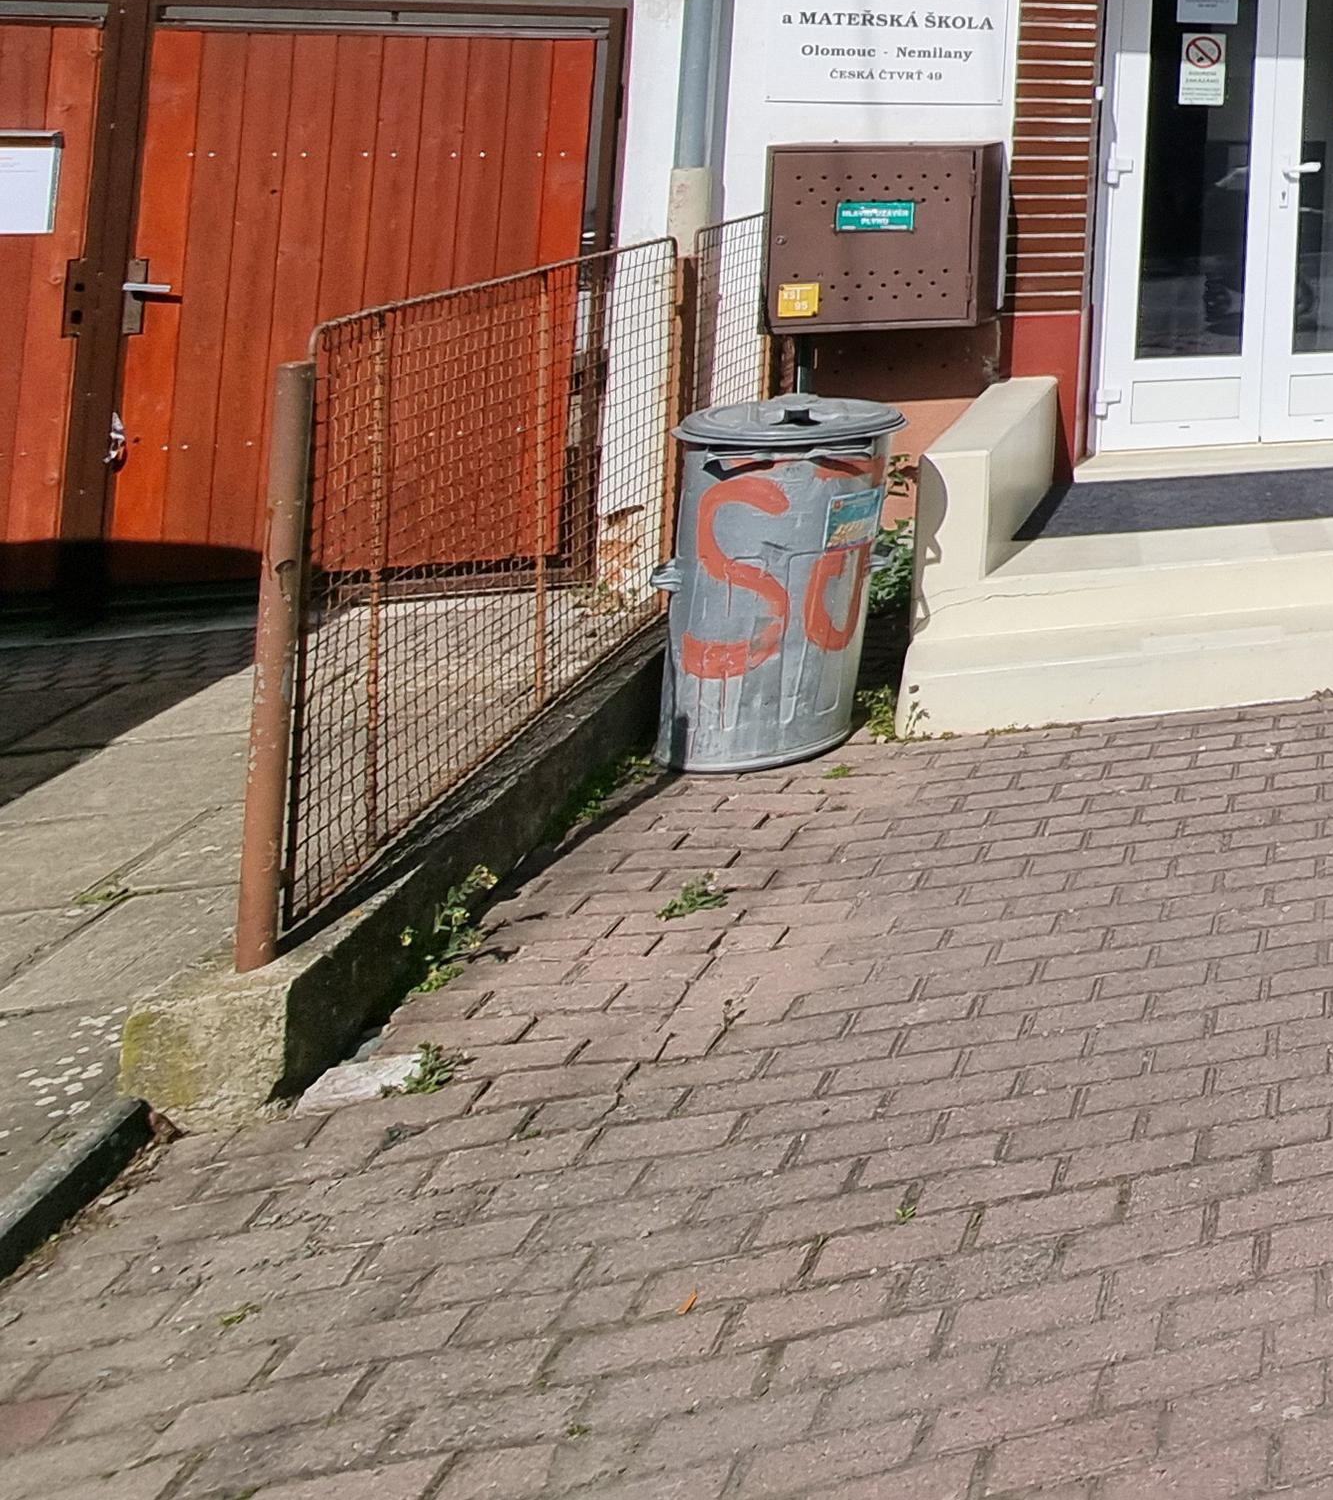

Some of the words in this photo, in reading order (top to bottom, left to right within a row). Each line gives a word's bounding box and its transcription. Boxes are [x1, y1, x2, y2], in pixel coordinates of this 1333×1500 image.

[782, 13, 793, 25] a
[799, 9, 919, 29] MATEŘSKÁ
[924, 11, 994, 30] ŠKOLA
[801, 44, 877, 58] Olomouc
[896, 46, 973, 62] Nemilany
[829, 67, 875, 80] ČESKÁ
